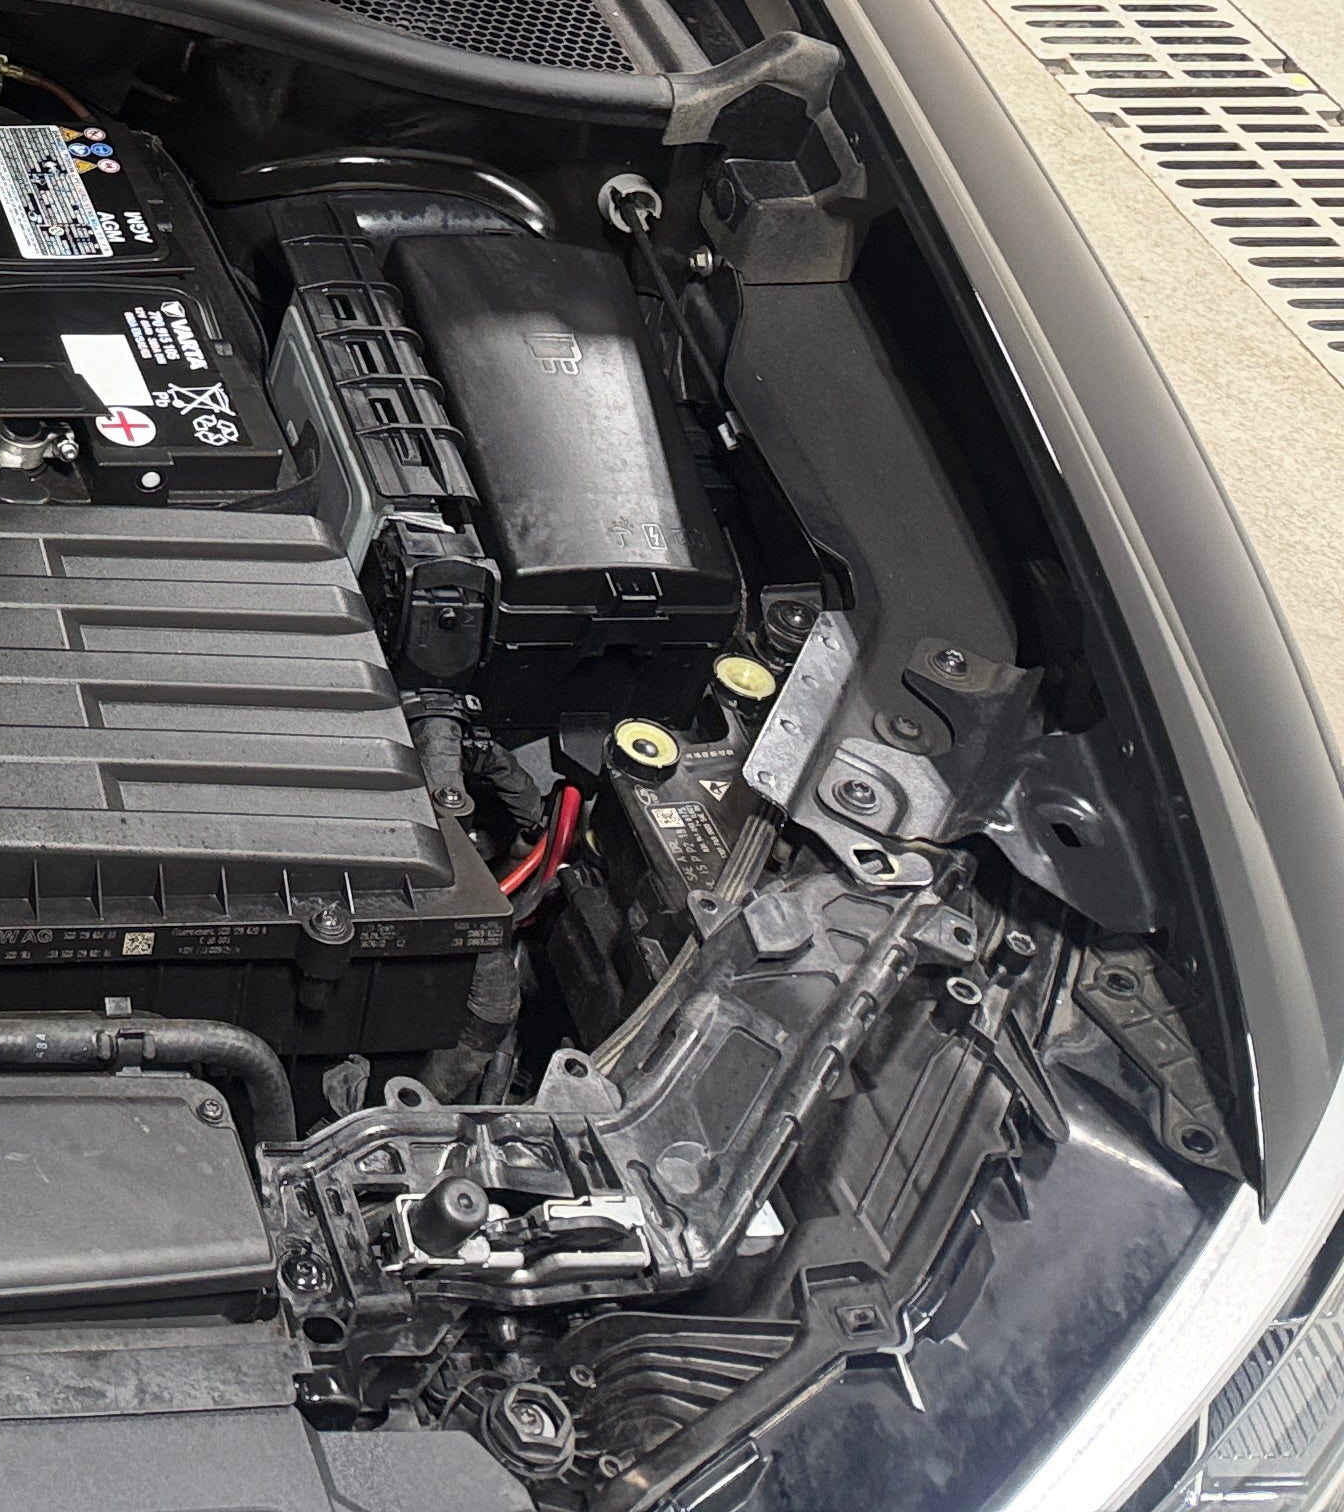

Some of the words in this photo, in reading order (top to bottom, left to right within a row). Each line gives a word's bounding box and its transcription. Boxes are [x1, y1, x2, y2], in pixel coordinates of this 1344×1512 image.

[96, 211, 126, 244] AGM
[123, 211, 154, 244] AGM
[170, 318, 209, 371] VARTA
[151, 391, 171, 408] Pb
[21, 928, 54, 944] AG
